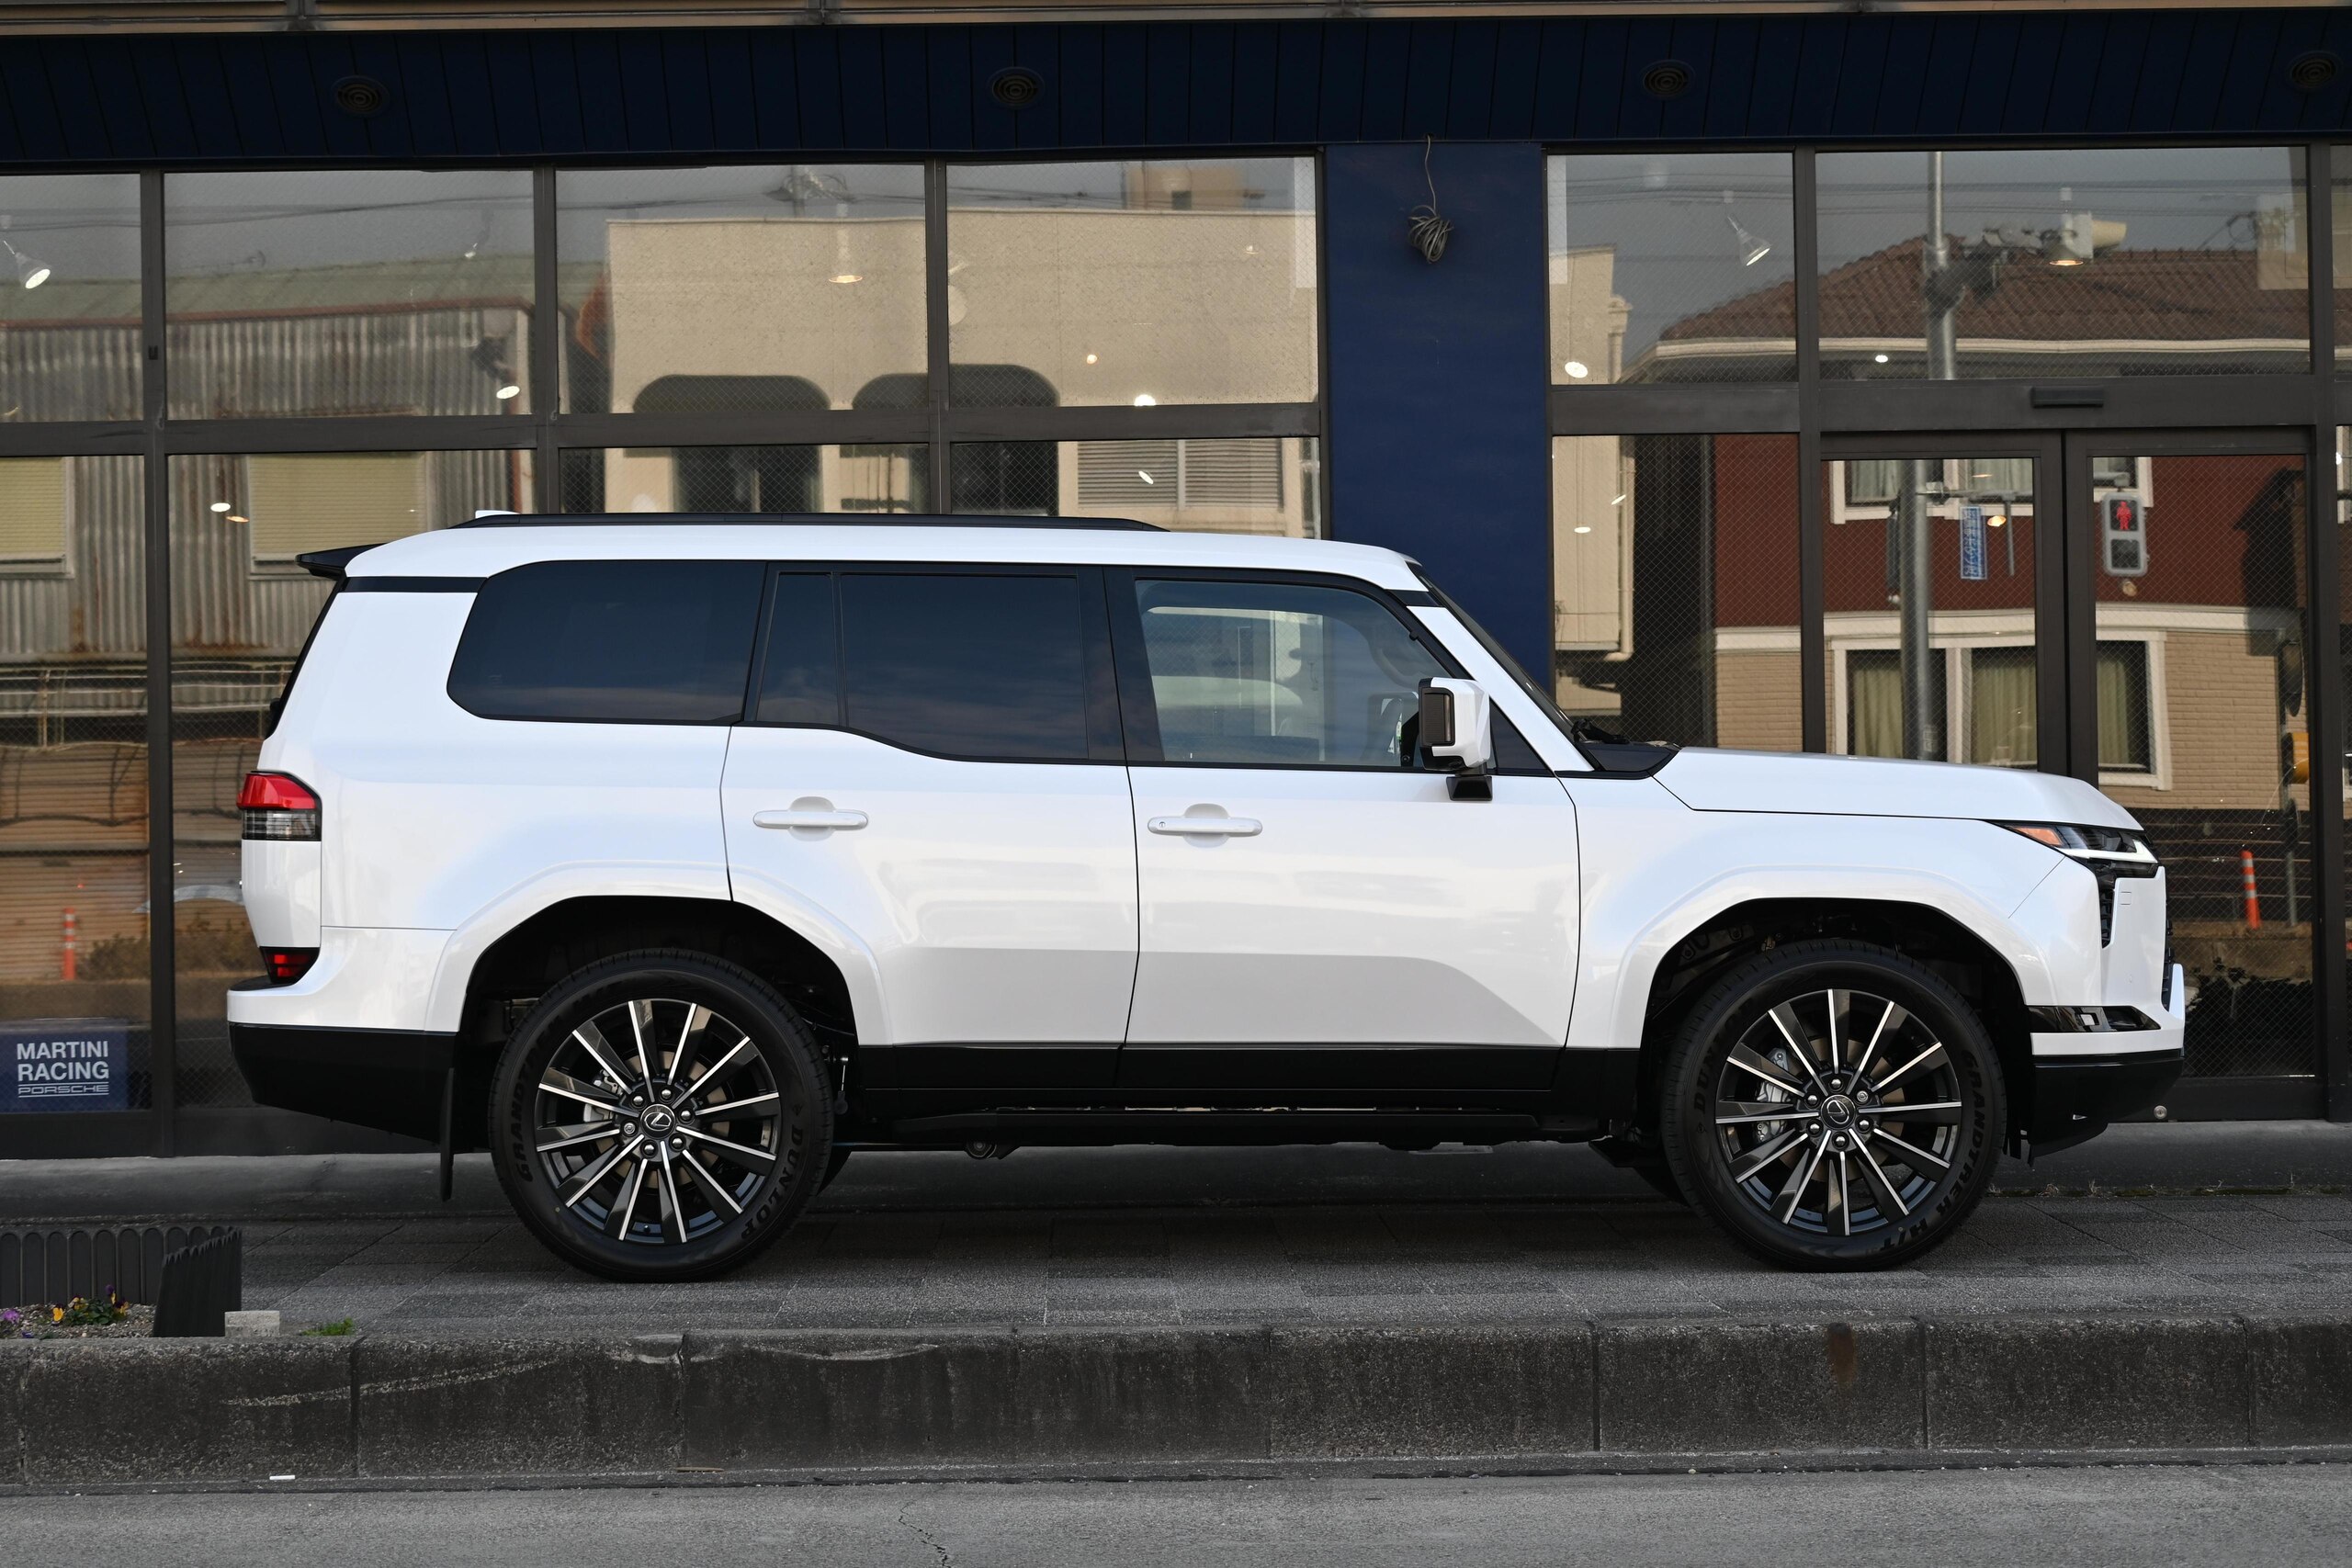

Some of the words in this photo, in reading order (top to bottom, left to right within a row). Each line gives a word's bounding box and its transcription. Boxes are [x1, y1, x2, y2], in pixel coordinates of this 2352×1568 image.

[17, 1040, 108, 1060] MARTINI
[17, 1061, 109, 1082] RACING
[18, 1085, 109, 1095] PORSCHE
[1936, 1050, 1985, 1215] GRANDTREK
[741, 1124, 803, 1239] DUNLOP
[1880, 1217, 1928, 1252] H/T
